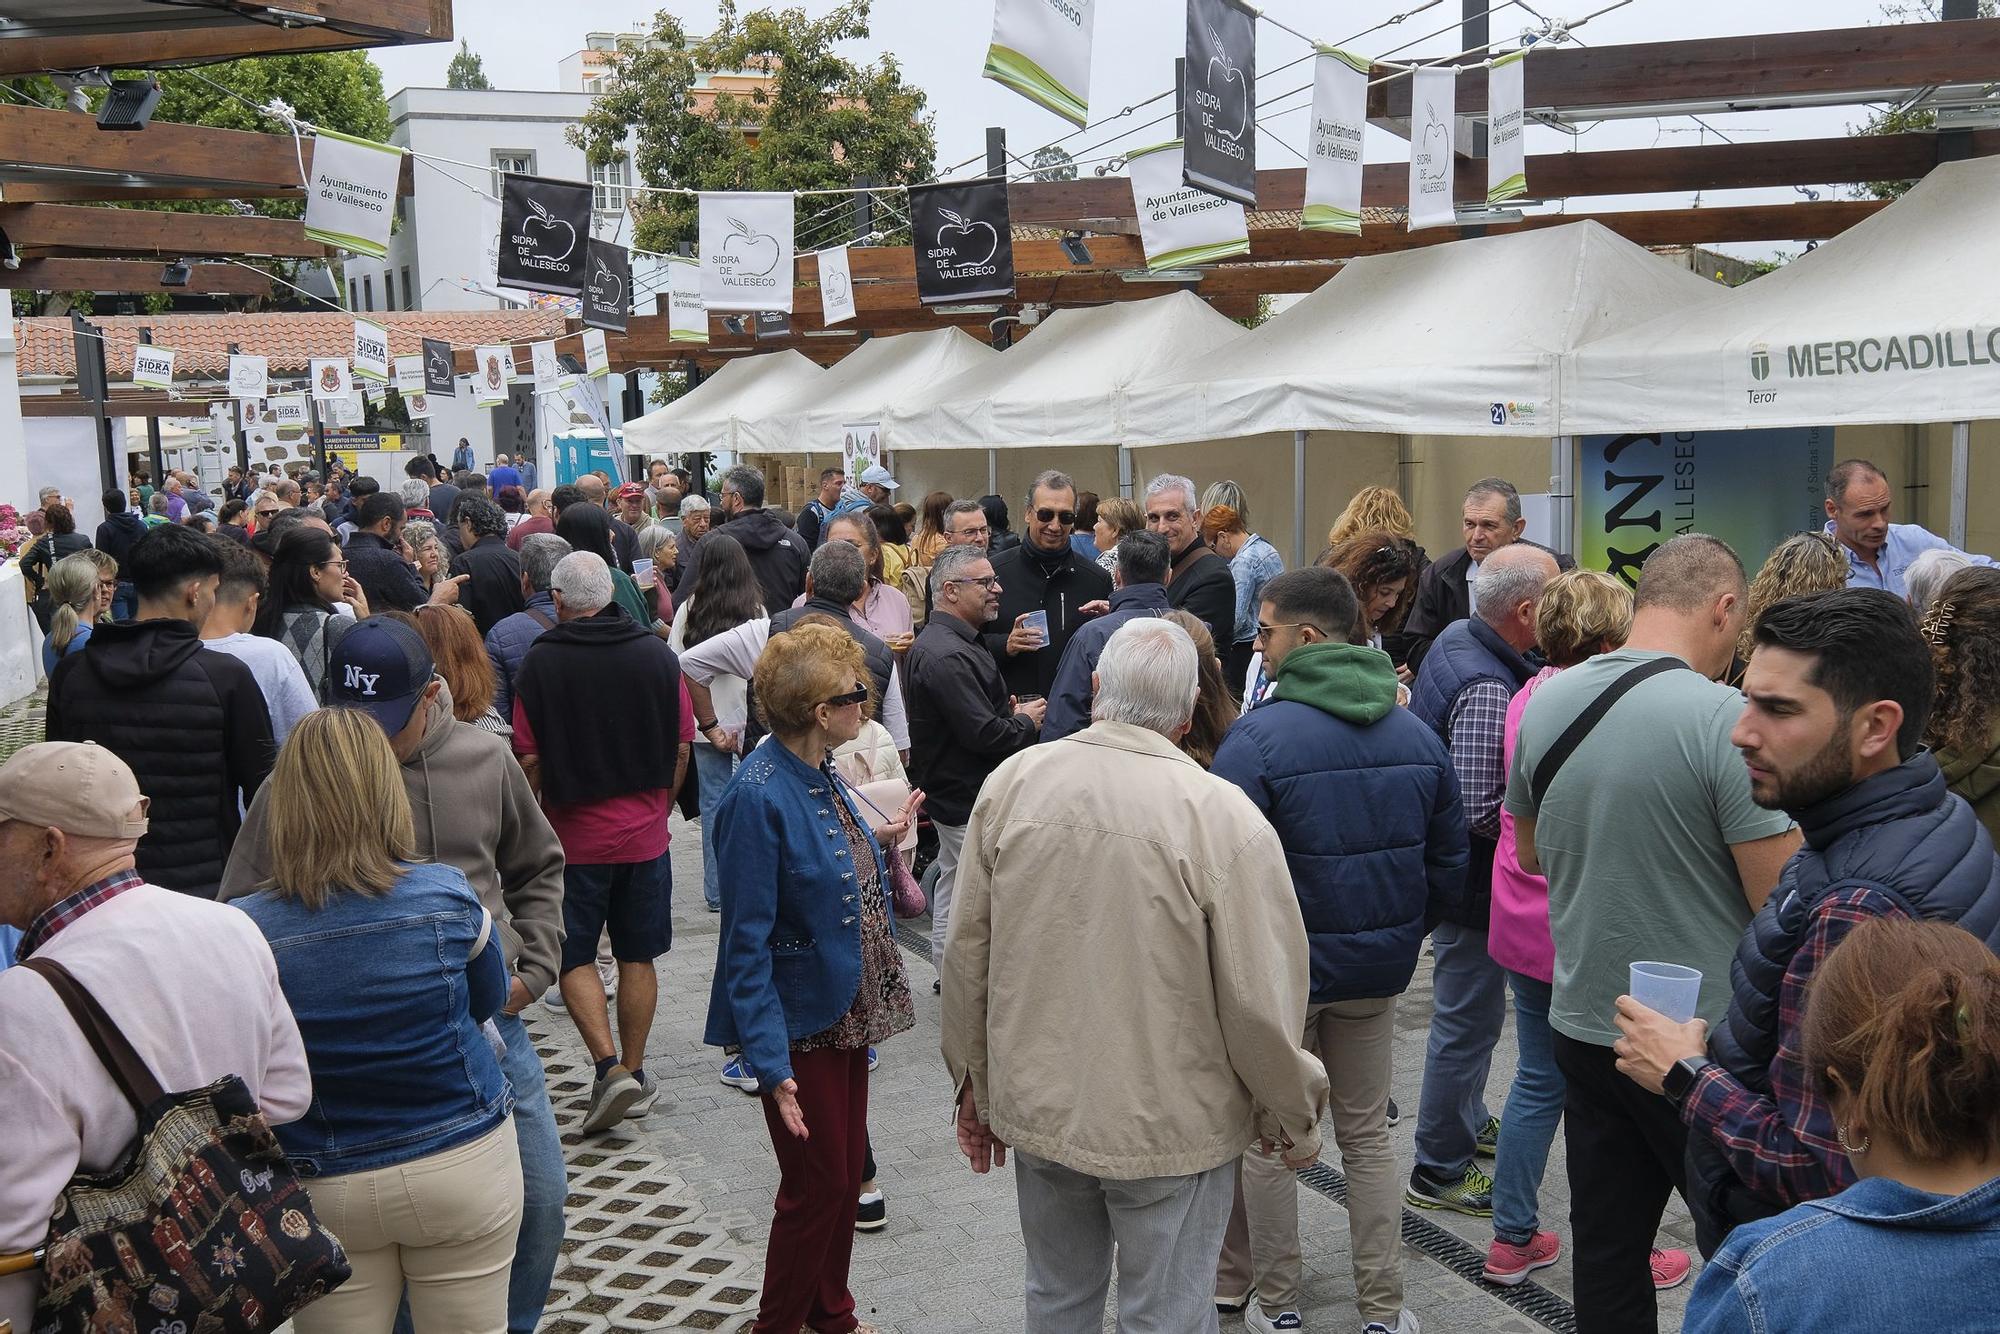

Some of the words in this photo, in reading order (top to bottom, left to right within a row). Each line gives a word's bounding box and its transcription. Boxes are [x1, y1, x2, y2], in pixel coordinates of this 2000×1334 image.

[1195, 90, 1221, 112] SIDRA
[1202, 114, 1214, 129] DE
[1492, 110, 1521, 131] Ayuntamiento
[1316, 118, 1362, 141] Ayuntamiento
[1493, 132, 1501, 145] de
[1204, 132, 1245, 161] VALLESECO
[1316, 140, 1326, 153] de
[1327, 142, 1358, 163] Valleseco
[1416, 153, 1432, 166] SIDRA
[1420, 168, 1427, 180] DE
[319, 174, 389, 200] Ayuntamiento
[1420, 180, 1447, 194] VALLESECO
[320, 188, 334, 200] de
[336, 191, 383, 212] Valleseco
[1146, 189, 1208, 209] Ayuntam
[1152, 210, 1167, 221] de
[1169, 198, 1228, 217] Valleseco
[511, 234, 538, 247] SIDRA
[518, 246, 530, 256] DE
[927, 247, 957, 259] SIDRA
[519, 257, 570, 273] VALLESECO
[712, 255, 740, 264] SIDRA
[936, 259, 950, 269] DE
[719, 267, 732, 275] DE
[939, 265, 997, 280] VALLESECO
[722, 277, 776, 287] VALLESECO
[588, 285, 604, 295] SIDRA
[672, 290, 700, 299] Ayuntamient
[591, 294, 599, 302] DE
[592, 302, 620, 315] VALLESECO
[357, 340, 386, 358] SIDRA
[138, 360, 170, 372] SIDRA
[1747, 389, 1777, 403] Teror
[1674, 432, 1695, 536] ALLESEC
[344, 664, 380, 695] NY
